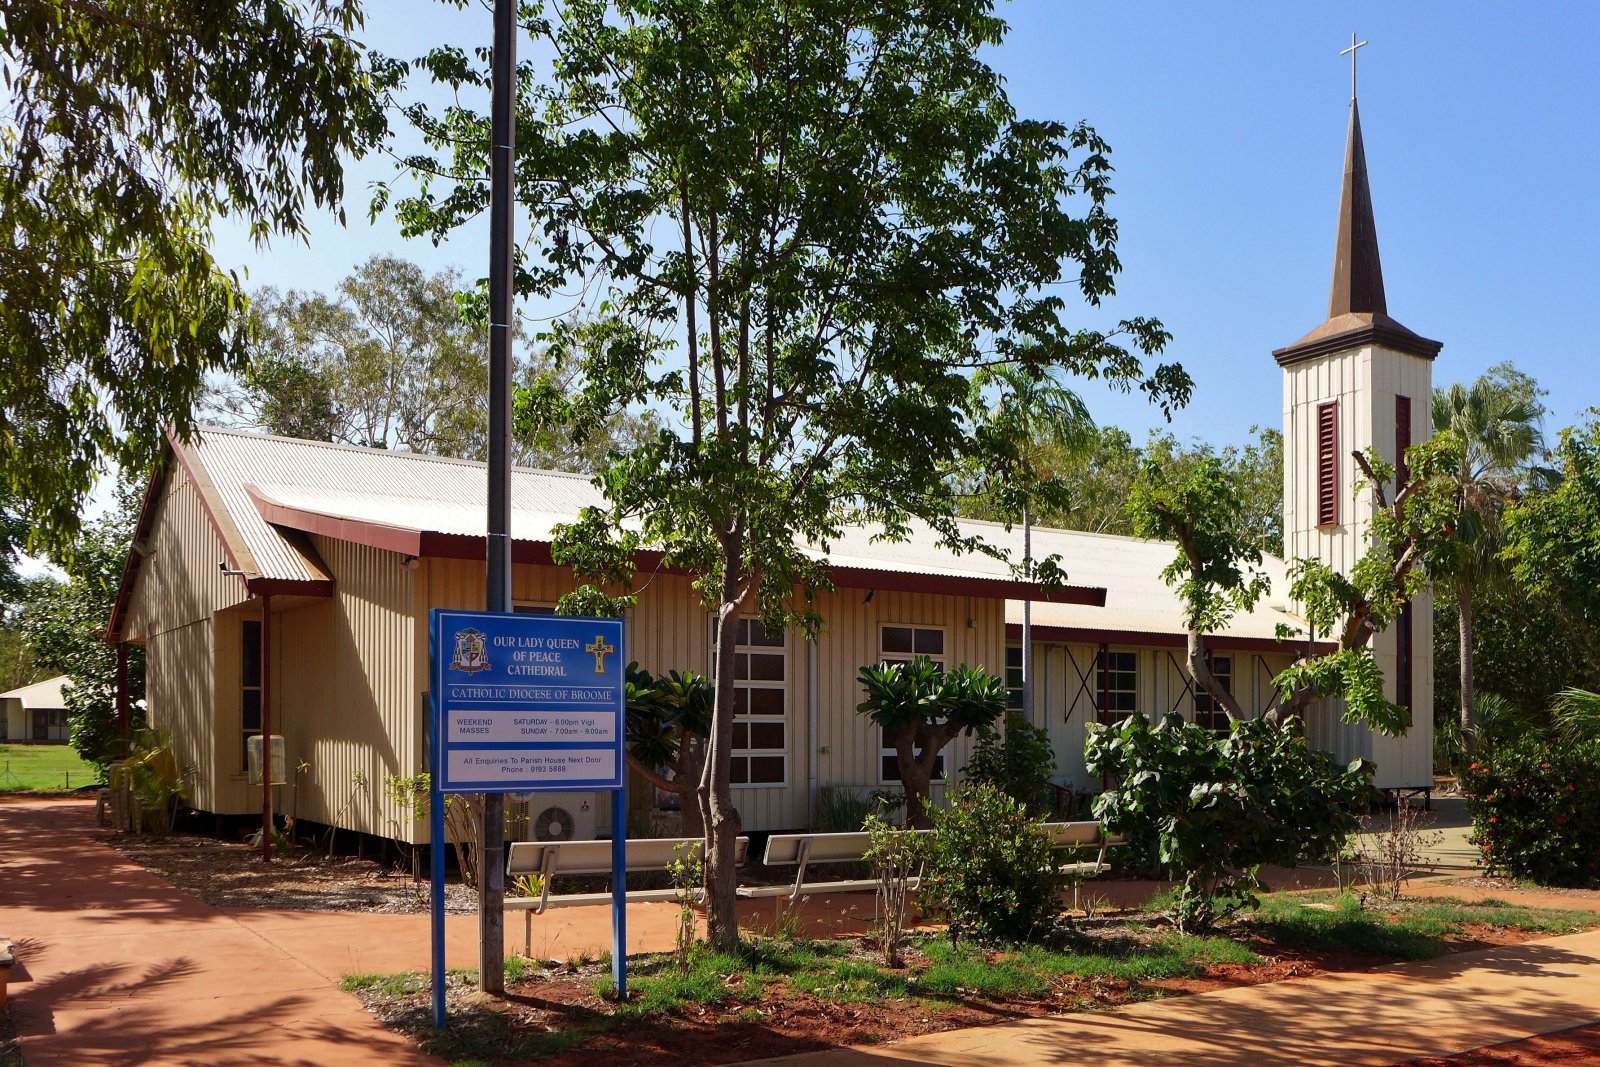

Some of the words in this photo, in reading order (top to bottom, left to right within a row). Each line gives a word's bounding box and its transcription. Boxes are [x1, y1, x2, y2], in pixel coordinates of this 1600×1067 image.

[494, 636, 516, 647] OUR
[518, 637, 545, 648] LADY
[547, 638, 580, 650] QUEEN
[513, 651, 527, 662] OF
[529, 652, 561, 662] PEACE
[507, 665, 567, 676] CATHEDRAL
[452, 688, 506, 699] CATHOLIC
[509, 689, 552, 700] DIOCESE
[554, 690, 568, 700] OF
[571, 690, 612, 700] BROOME
